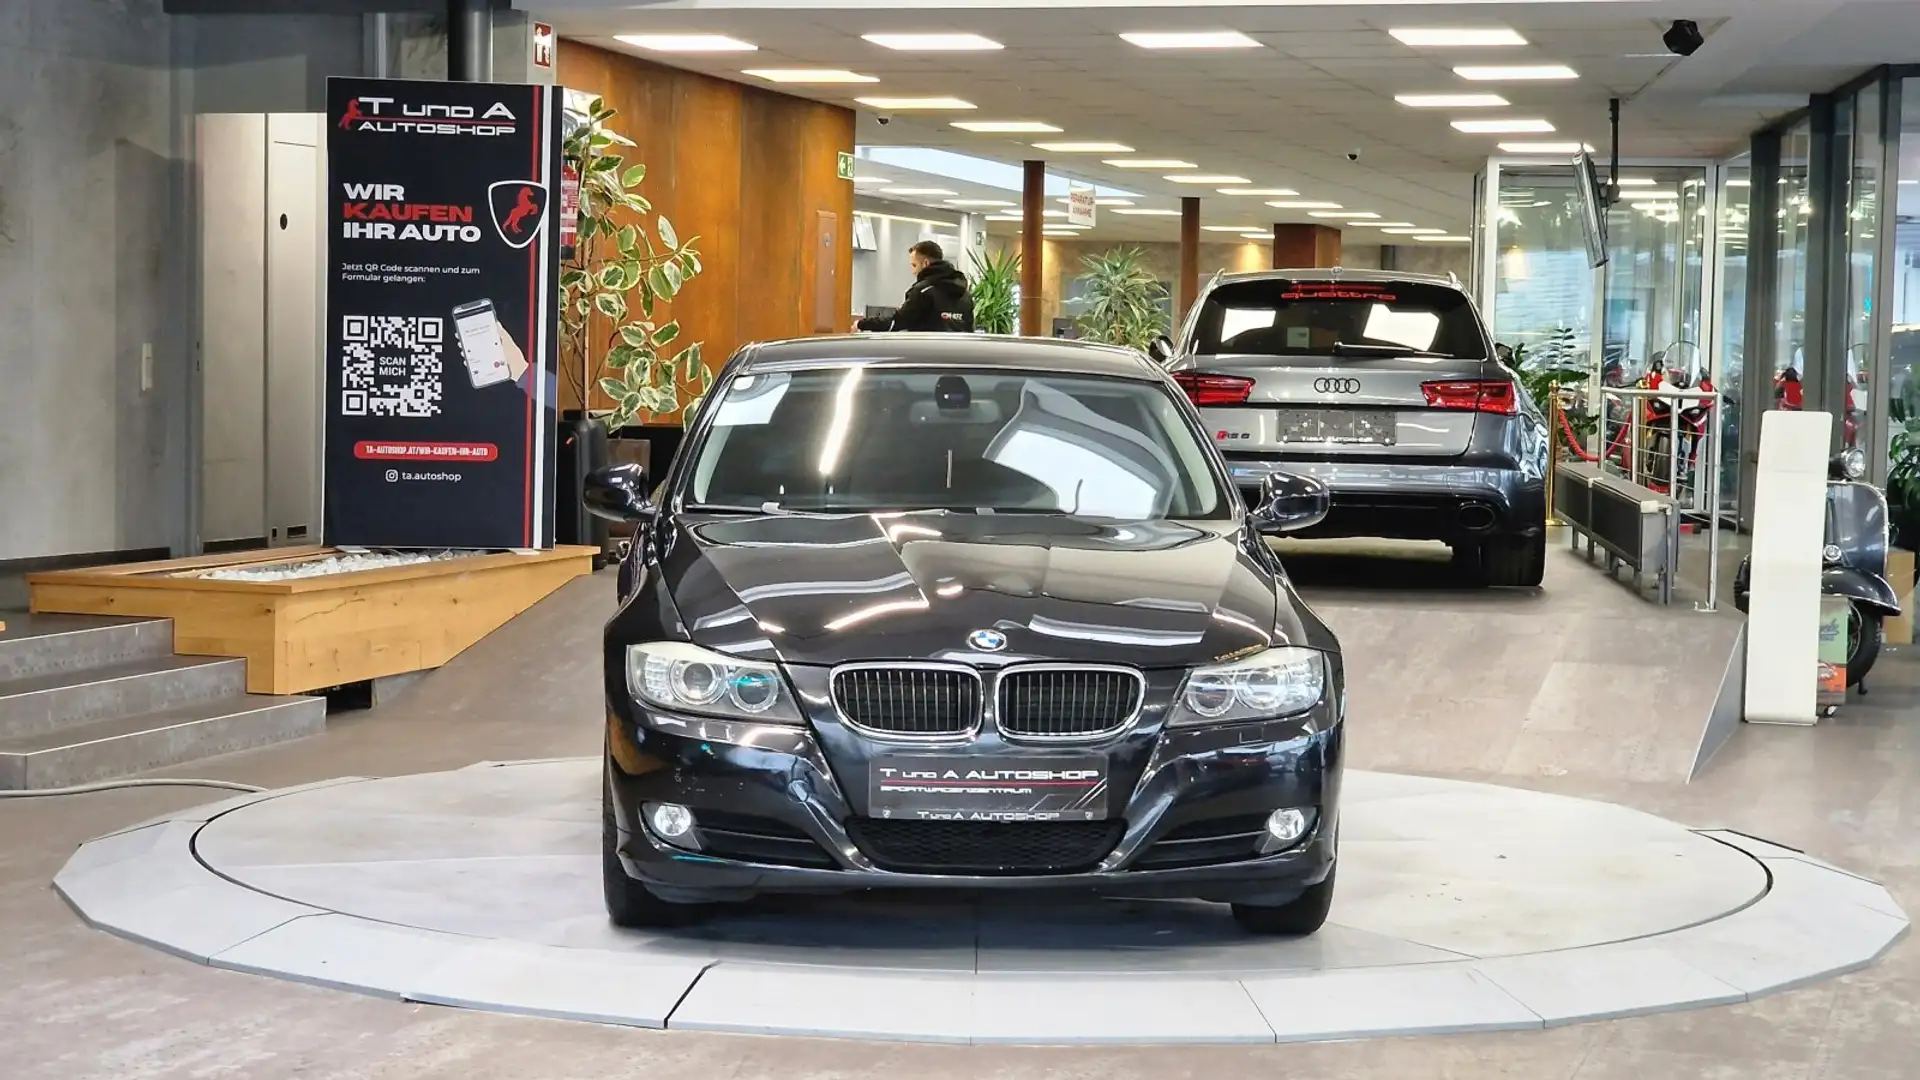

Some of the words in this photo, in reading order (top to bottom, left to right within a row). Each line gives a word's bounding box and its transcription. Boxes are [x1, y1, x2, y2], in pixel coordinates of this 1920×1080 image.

[358, 97, 394, 115] T
[481, 101, 516, 120] A
[358, 121, 516, 136] AUTOSHOP
[343, 183, 405, 201] WIR
[343, 203, 473, 222] KAUFEN
[343, 222, 395, 239] IHR
[398, 225, 482, 242] AUTO
[342, 263, 363, 271] Jetzt
[365, 264, 379, 272] QR
[380, 264, 402, 272] Code
[404, 265, 440, 273] scannen
[442, 266, 459, 274] und
[342, 273, 381, 281] Formular
[379, 356, 406, 366] SCAN
[379, 367, 406, 376] MICH
[402, 471, 461, 482] ta.autoshop
[880, 768, 897, 777] T
[943, 770, 959, 779] A
[965, 770, 1099, 780] AUTOSHOP
[917, 811, 929, 819] T
[952, 812, 964, 820] A
[970, 812, 1060, 820] AUTOSHOP
